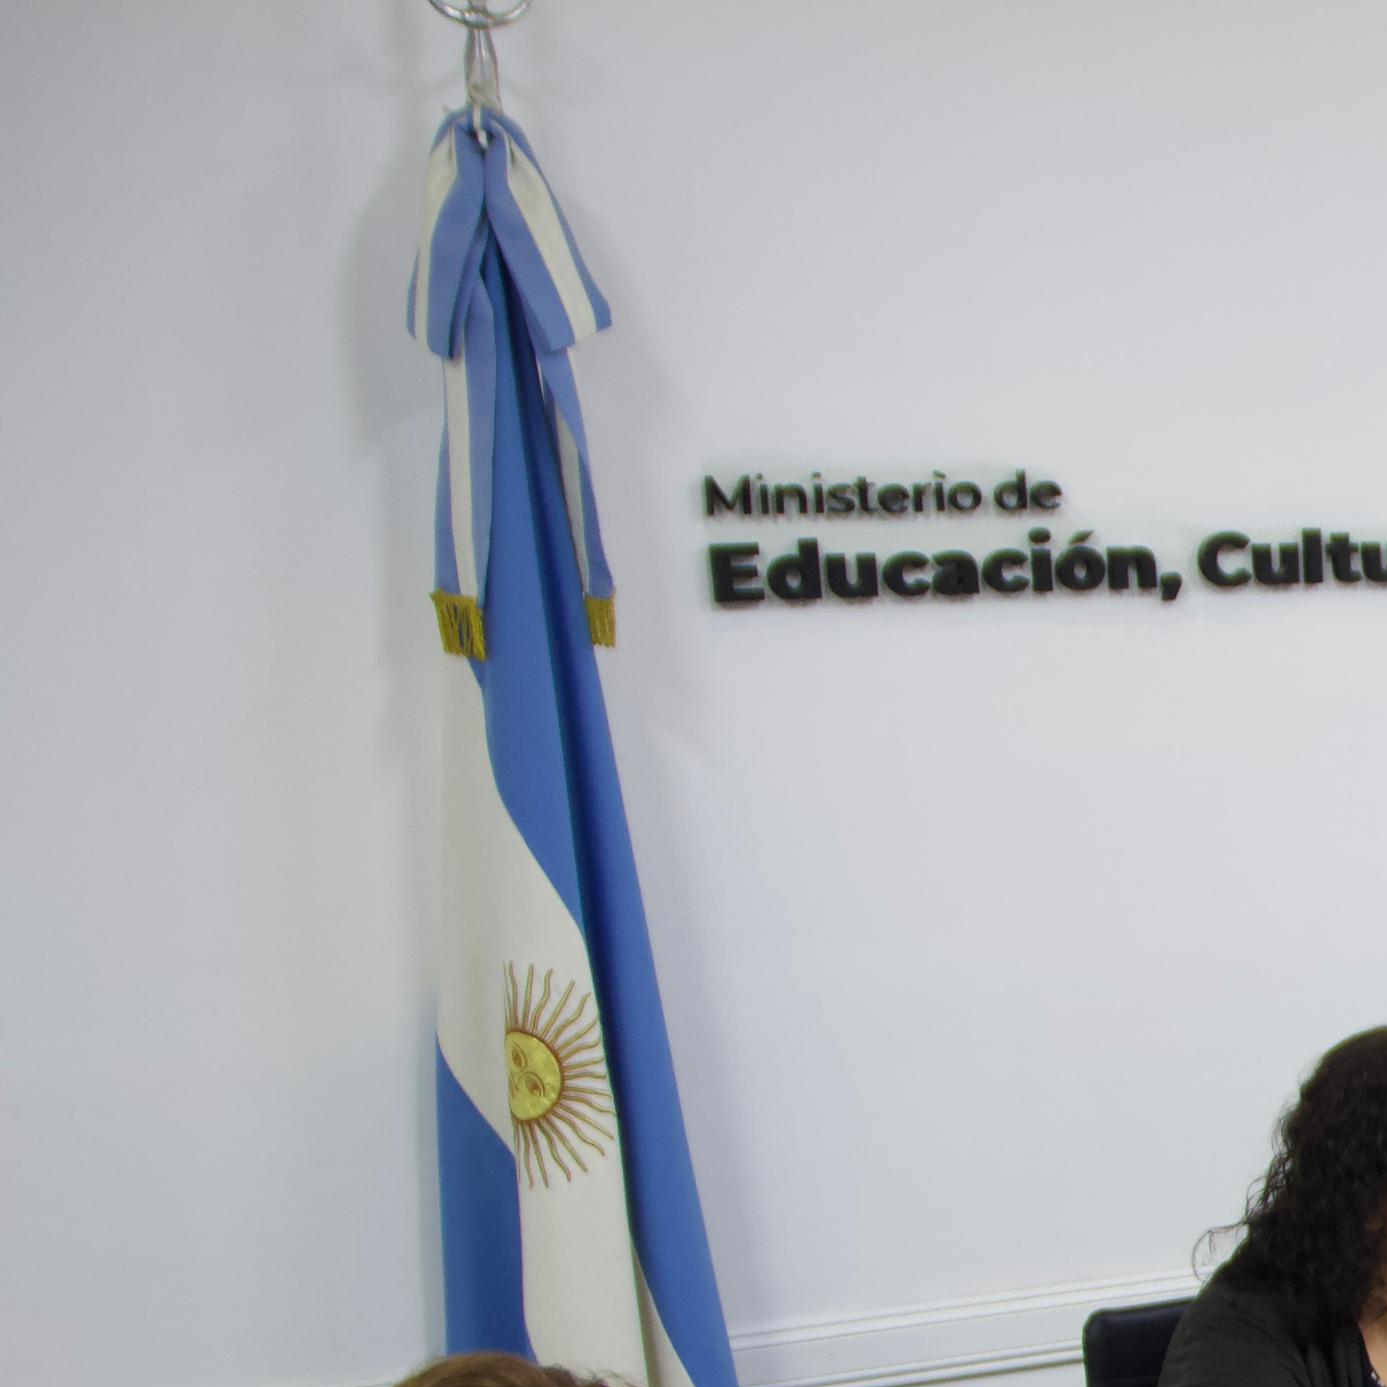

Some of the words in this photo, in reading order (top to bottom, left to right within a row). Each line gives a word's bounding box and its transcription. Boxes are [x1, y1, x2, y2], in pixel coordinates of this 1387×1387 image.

[703, 471, 982, 517] Ministerio
[993, 469, 1063, 511] de
[708, 527, 1183, 603] Educación,
